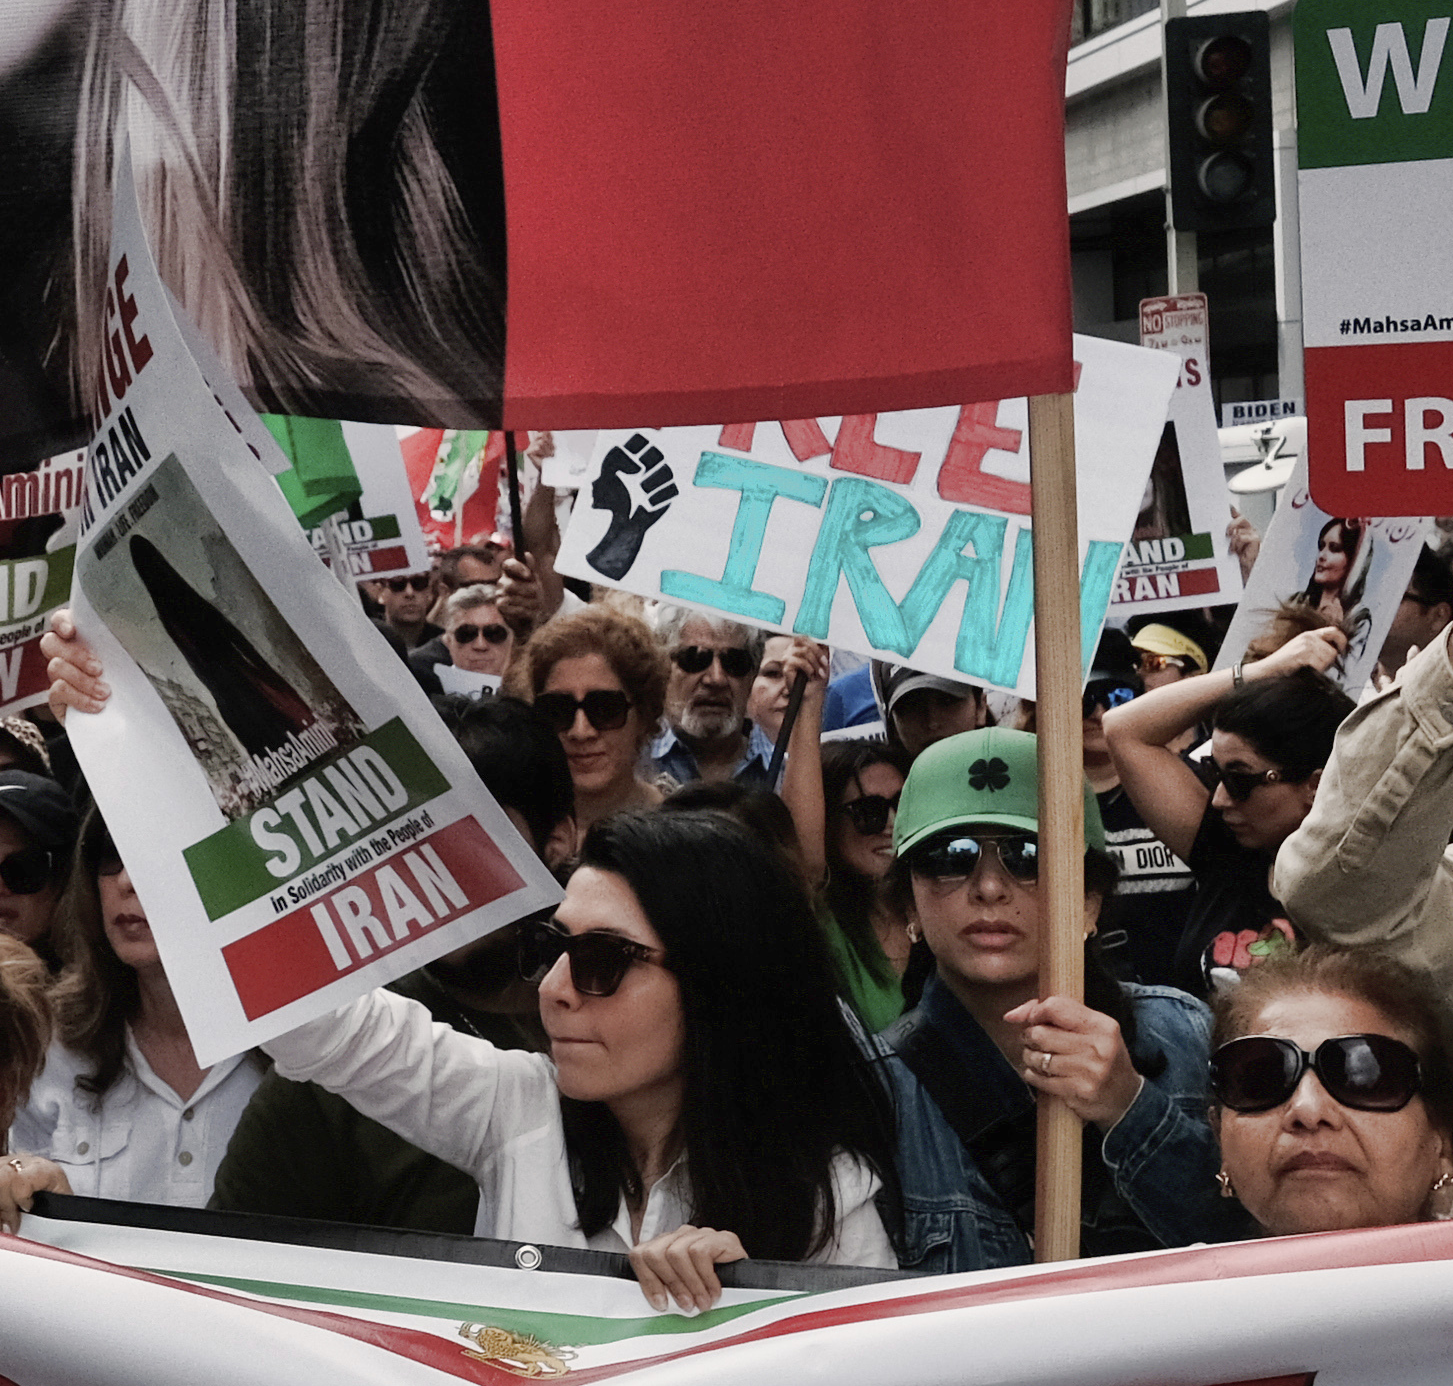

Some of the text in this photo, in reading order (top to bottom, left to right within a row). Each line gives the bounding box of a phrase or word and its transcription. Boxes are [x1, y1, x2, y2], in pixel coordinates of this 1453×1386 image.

[1143, 313, 1162, 332] NO
[1233, 401, 1295, 419] BIDEN
[92, 405, 151, 510] IRAN
[659, 450, 1125, 689] IRAN
[1124, 536, 1185, 565] AND
[1112, 572, 1181, 603] RAN
[33, 617, 46, 635] of
[236, 718, 339, 797] #MahsaAmini
[249, 744, 409, 879] STAND
[270, 809, 435, 914] in Solidarity with the People of
[1136, 844, 1175, 870] DIOR
[309, 842, 471, 972] IRAN
